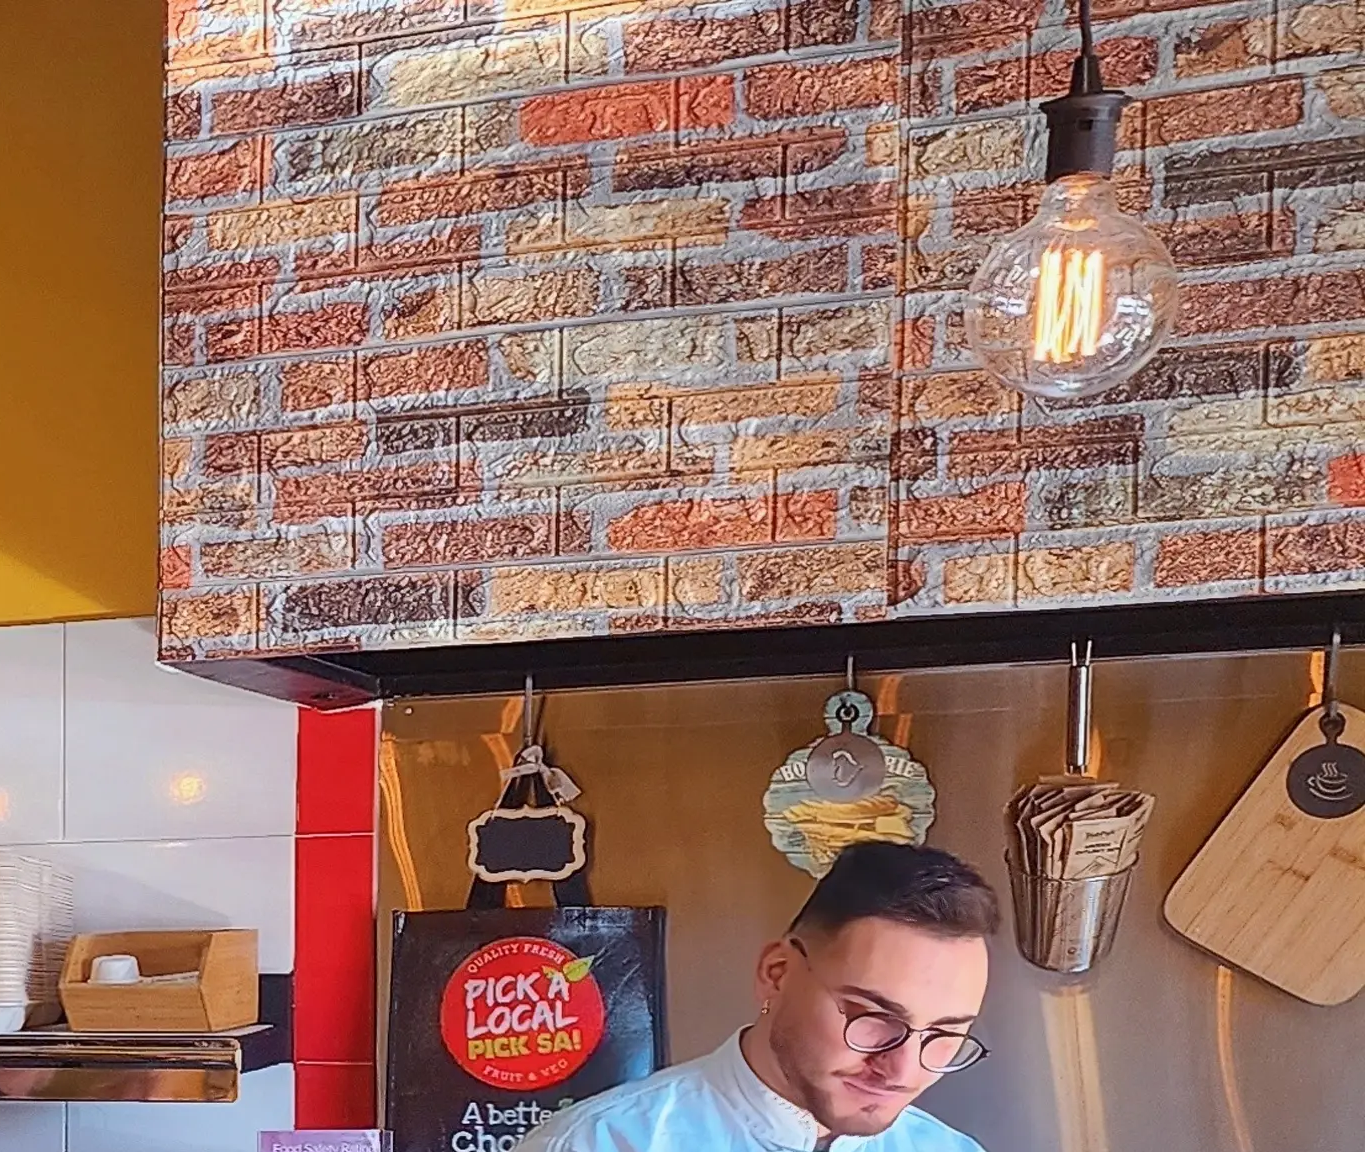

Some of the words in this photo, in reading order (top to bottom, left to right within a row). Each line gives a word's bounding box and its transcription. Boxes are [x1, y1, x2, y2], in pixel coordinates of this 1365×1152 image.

[468, 943, 520, 974] QUALITY
[523, 943, 565, 965] FRESH
[465, 972, 541, 1009] PICK
[548, 971, 570, 1001] A
[467, 1000, 579, 1039] LOCAL
[468, 1035, 530, 1060] PICK
[536, 1029, 581, 1053] SA!
[483, 1065, 524, 1082] FRUIT
[462, 1102, 483, 1125] A
[488, 1100, 559, 1125] bette
